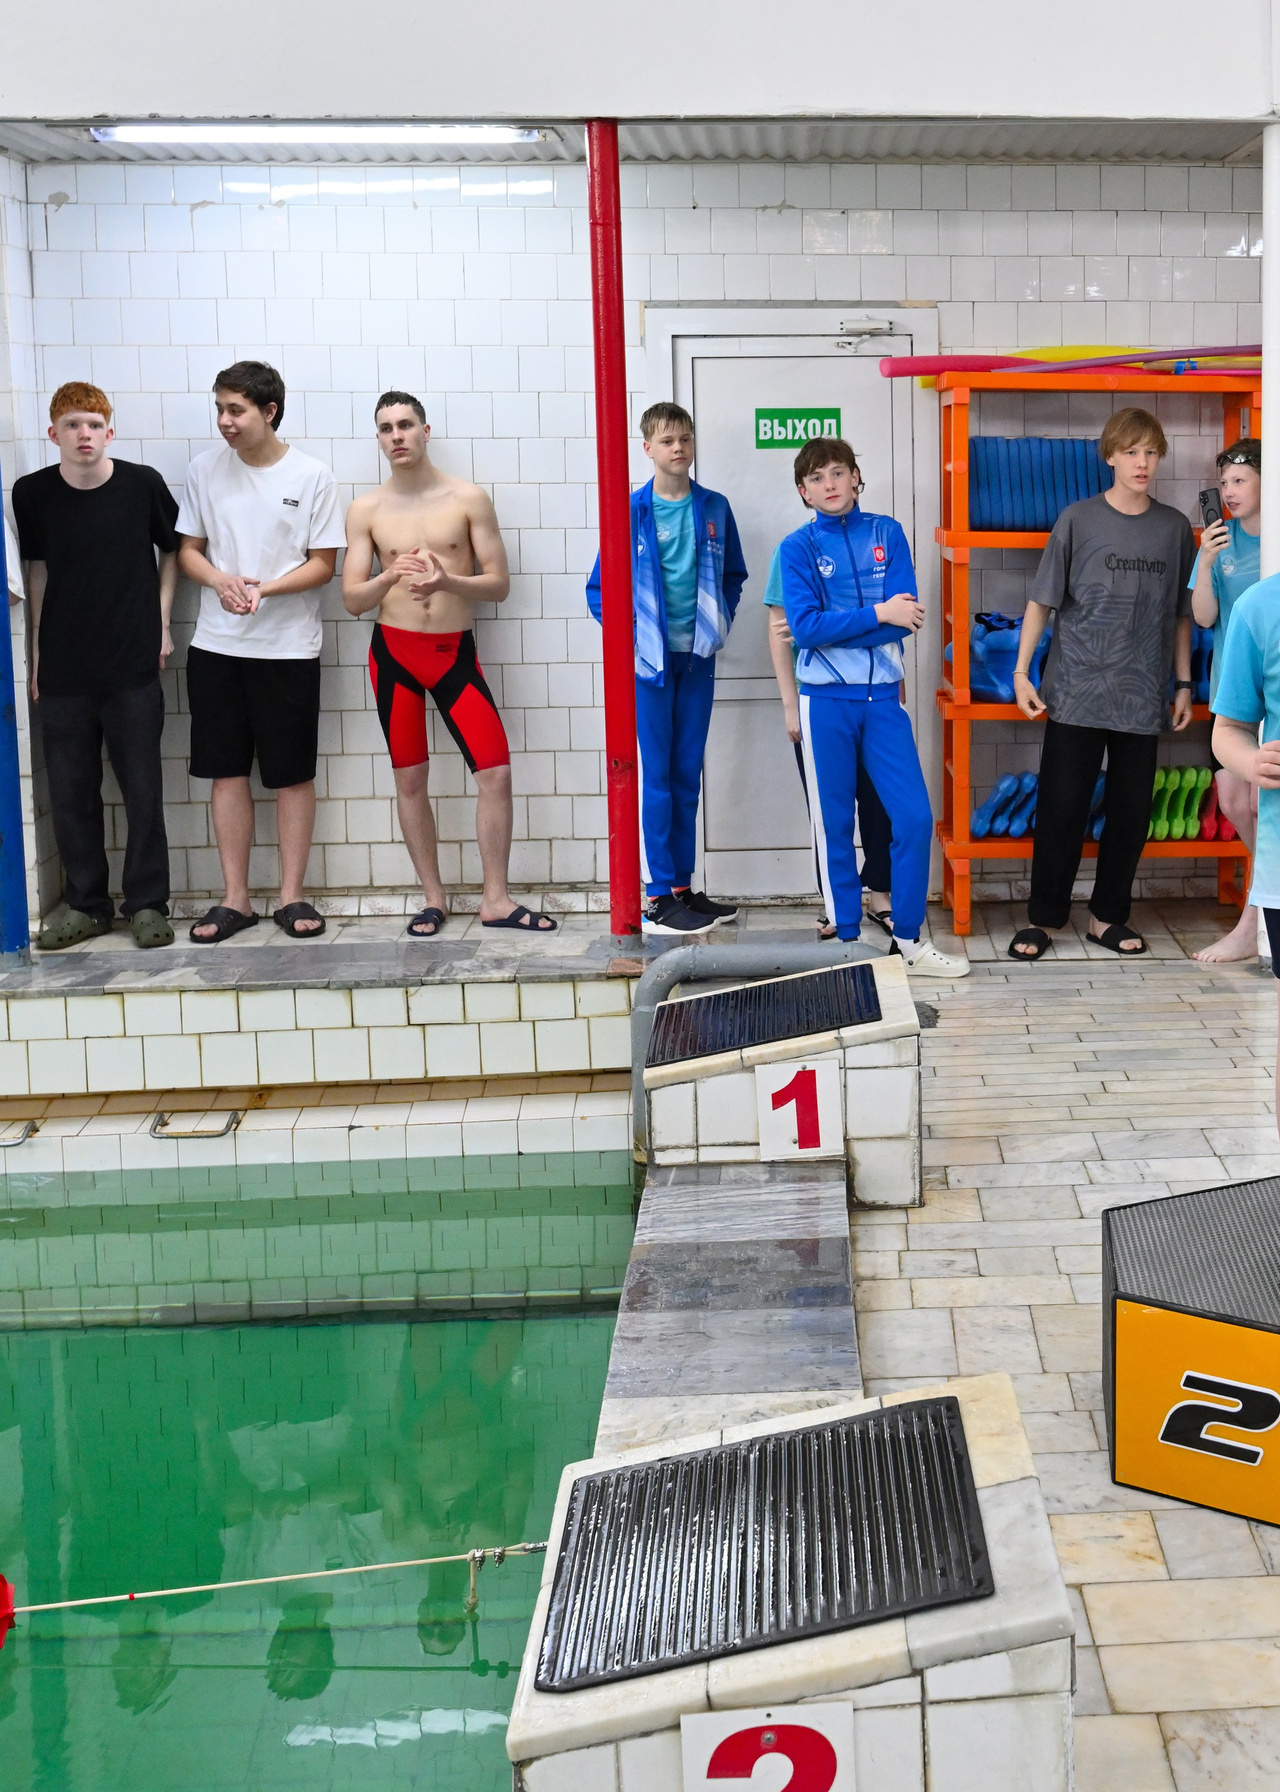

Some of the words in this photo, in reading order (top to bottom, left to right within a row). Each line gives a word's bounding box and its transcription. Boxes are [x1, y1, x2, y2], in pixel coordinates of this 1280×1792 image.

[759, 419, 838, 440] ВЫХОД
[1105, 553, 1166, 582] Creativity
[771, 1069, 821, 1149] 1
